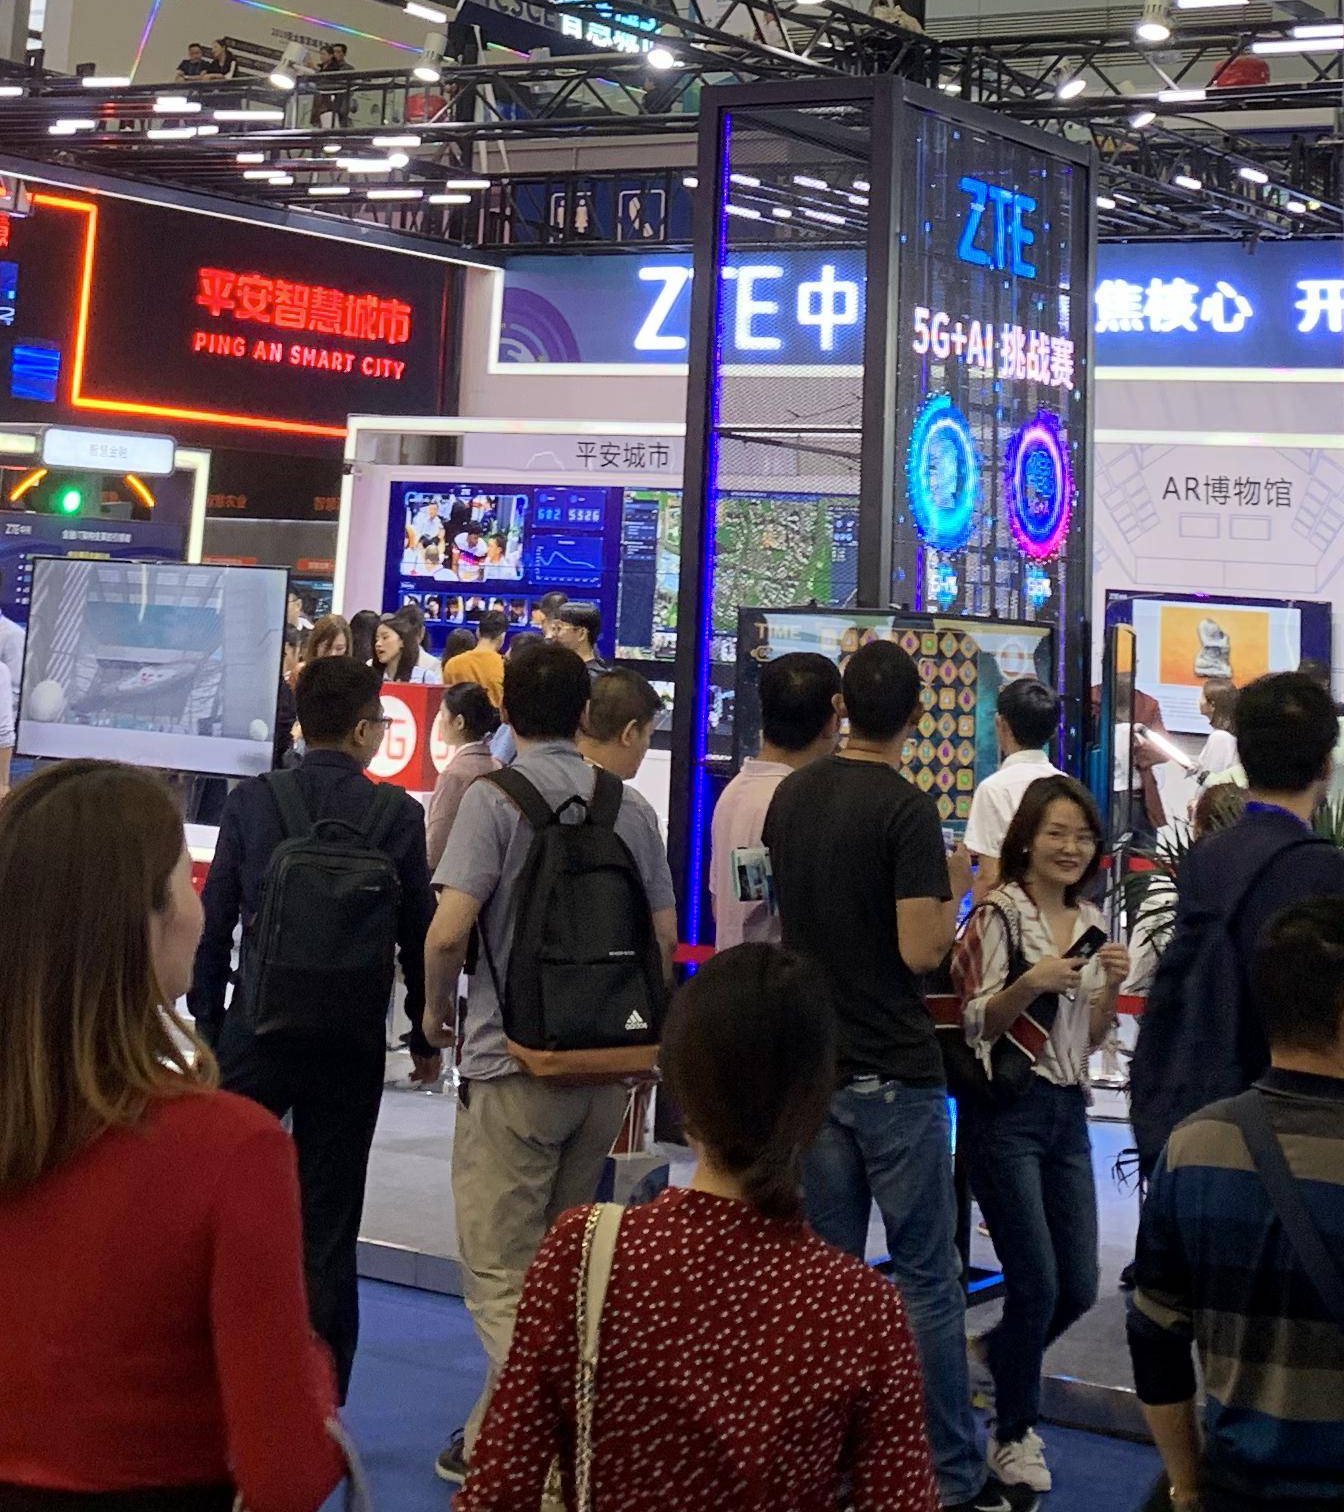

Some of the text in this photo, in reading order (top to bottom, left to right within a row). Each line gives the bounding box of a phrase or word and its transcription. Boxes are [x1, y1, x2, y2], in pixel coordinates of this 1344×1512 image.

[958, 176, 1037, 280] ZTE
[196, 267, 413, 345] 平安智慧城市
[633, 264, 867, 351] ZE中
[1094, 277, 1254, 333] 焦核心
[194, 330, 406, 381] PING AN SMART CITY
[998, 322, 1075, 391] 挑战赛
[576, 440, 670, 469] 平安城市
[1161, 474, 1293, 508] AR博物馆
